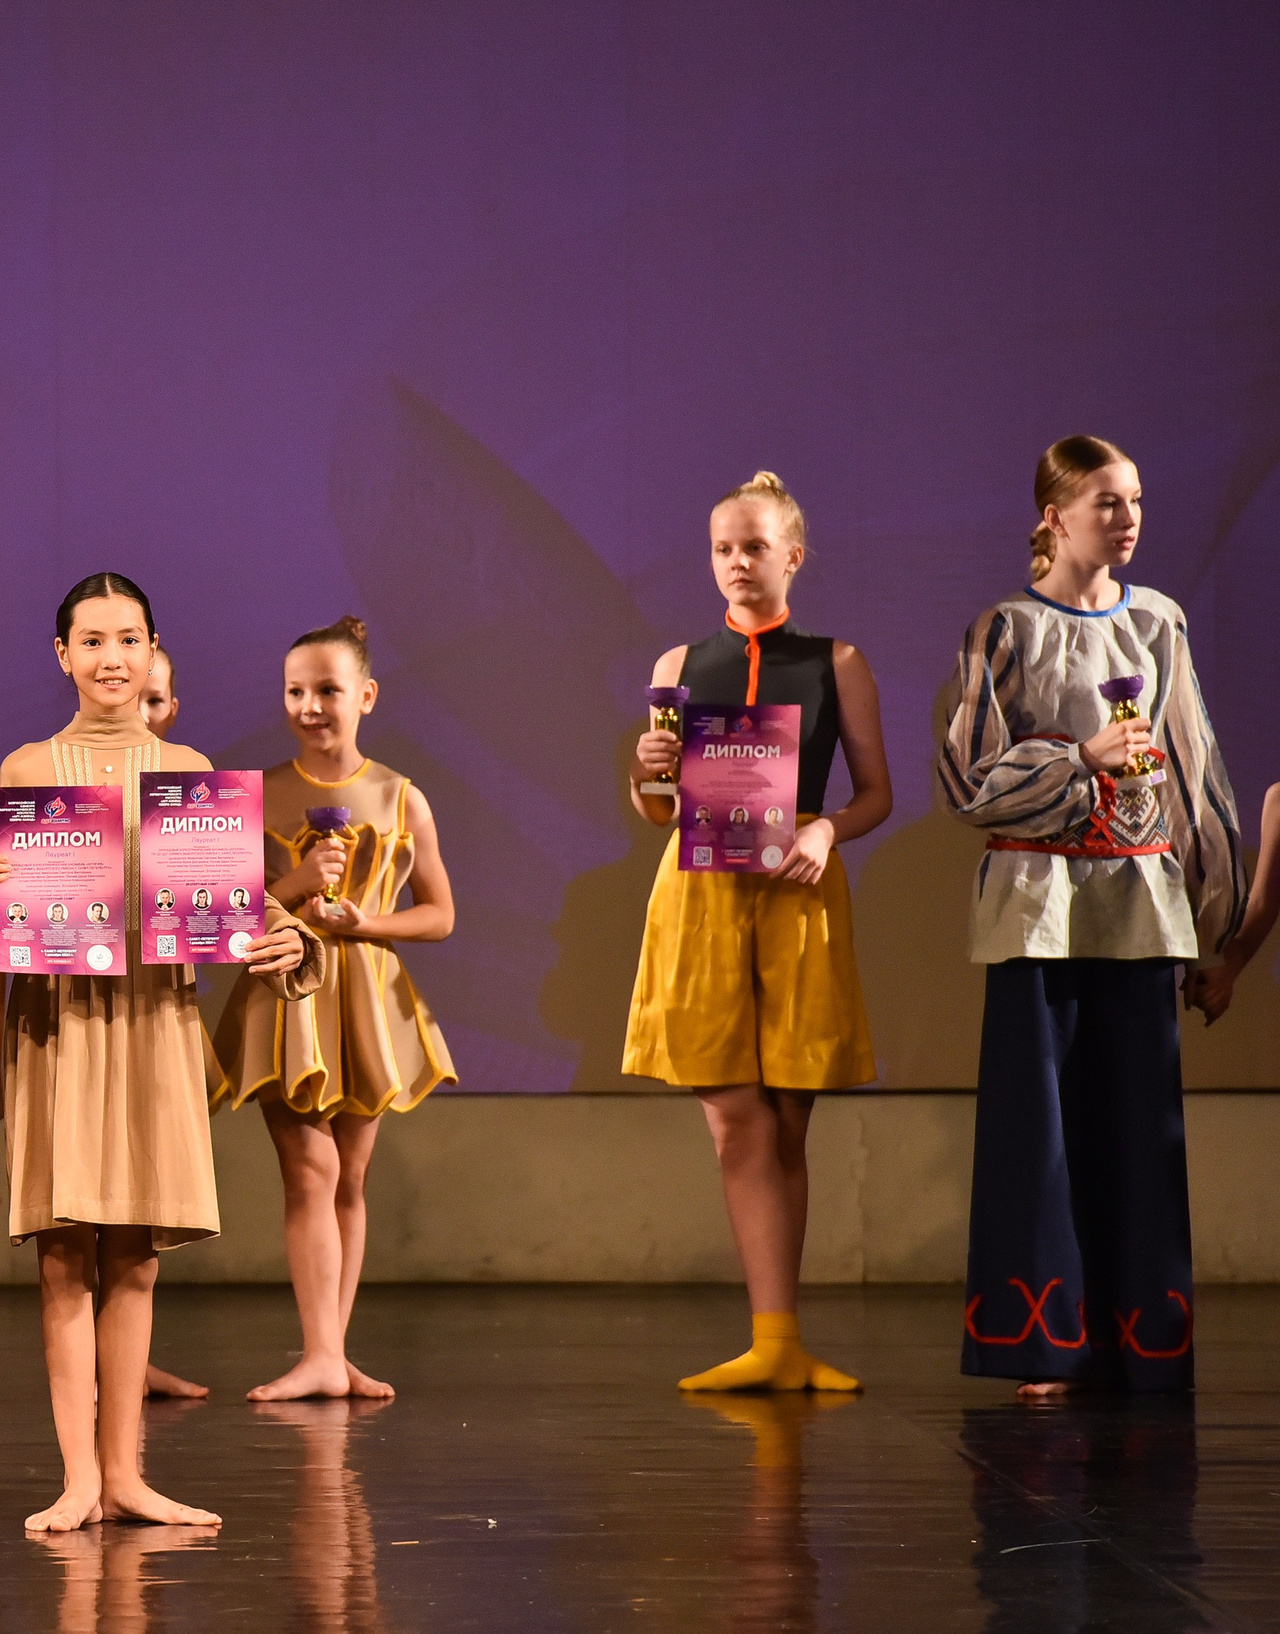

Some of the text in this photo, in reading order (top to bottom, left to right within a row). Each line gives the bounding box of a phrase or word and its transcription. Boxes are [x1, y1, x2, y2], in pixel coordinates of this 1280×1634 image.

[702, 744, 780, 760] ДИПЛОМ
[160, 817, 242, 834] ДИПЛОМ
[12, 832, 100, 850] ДИПЛОМ
